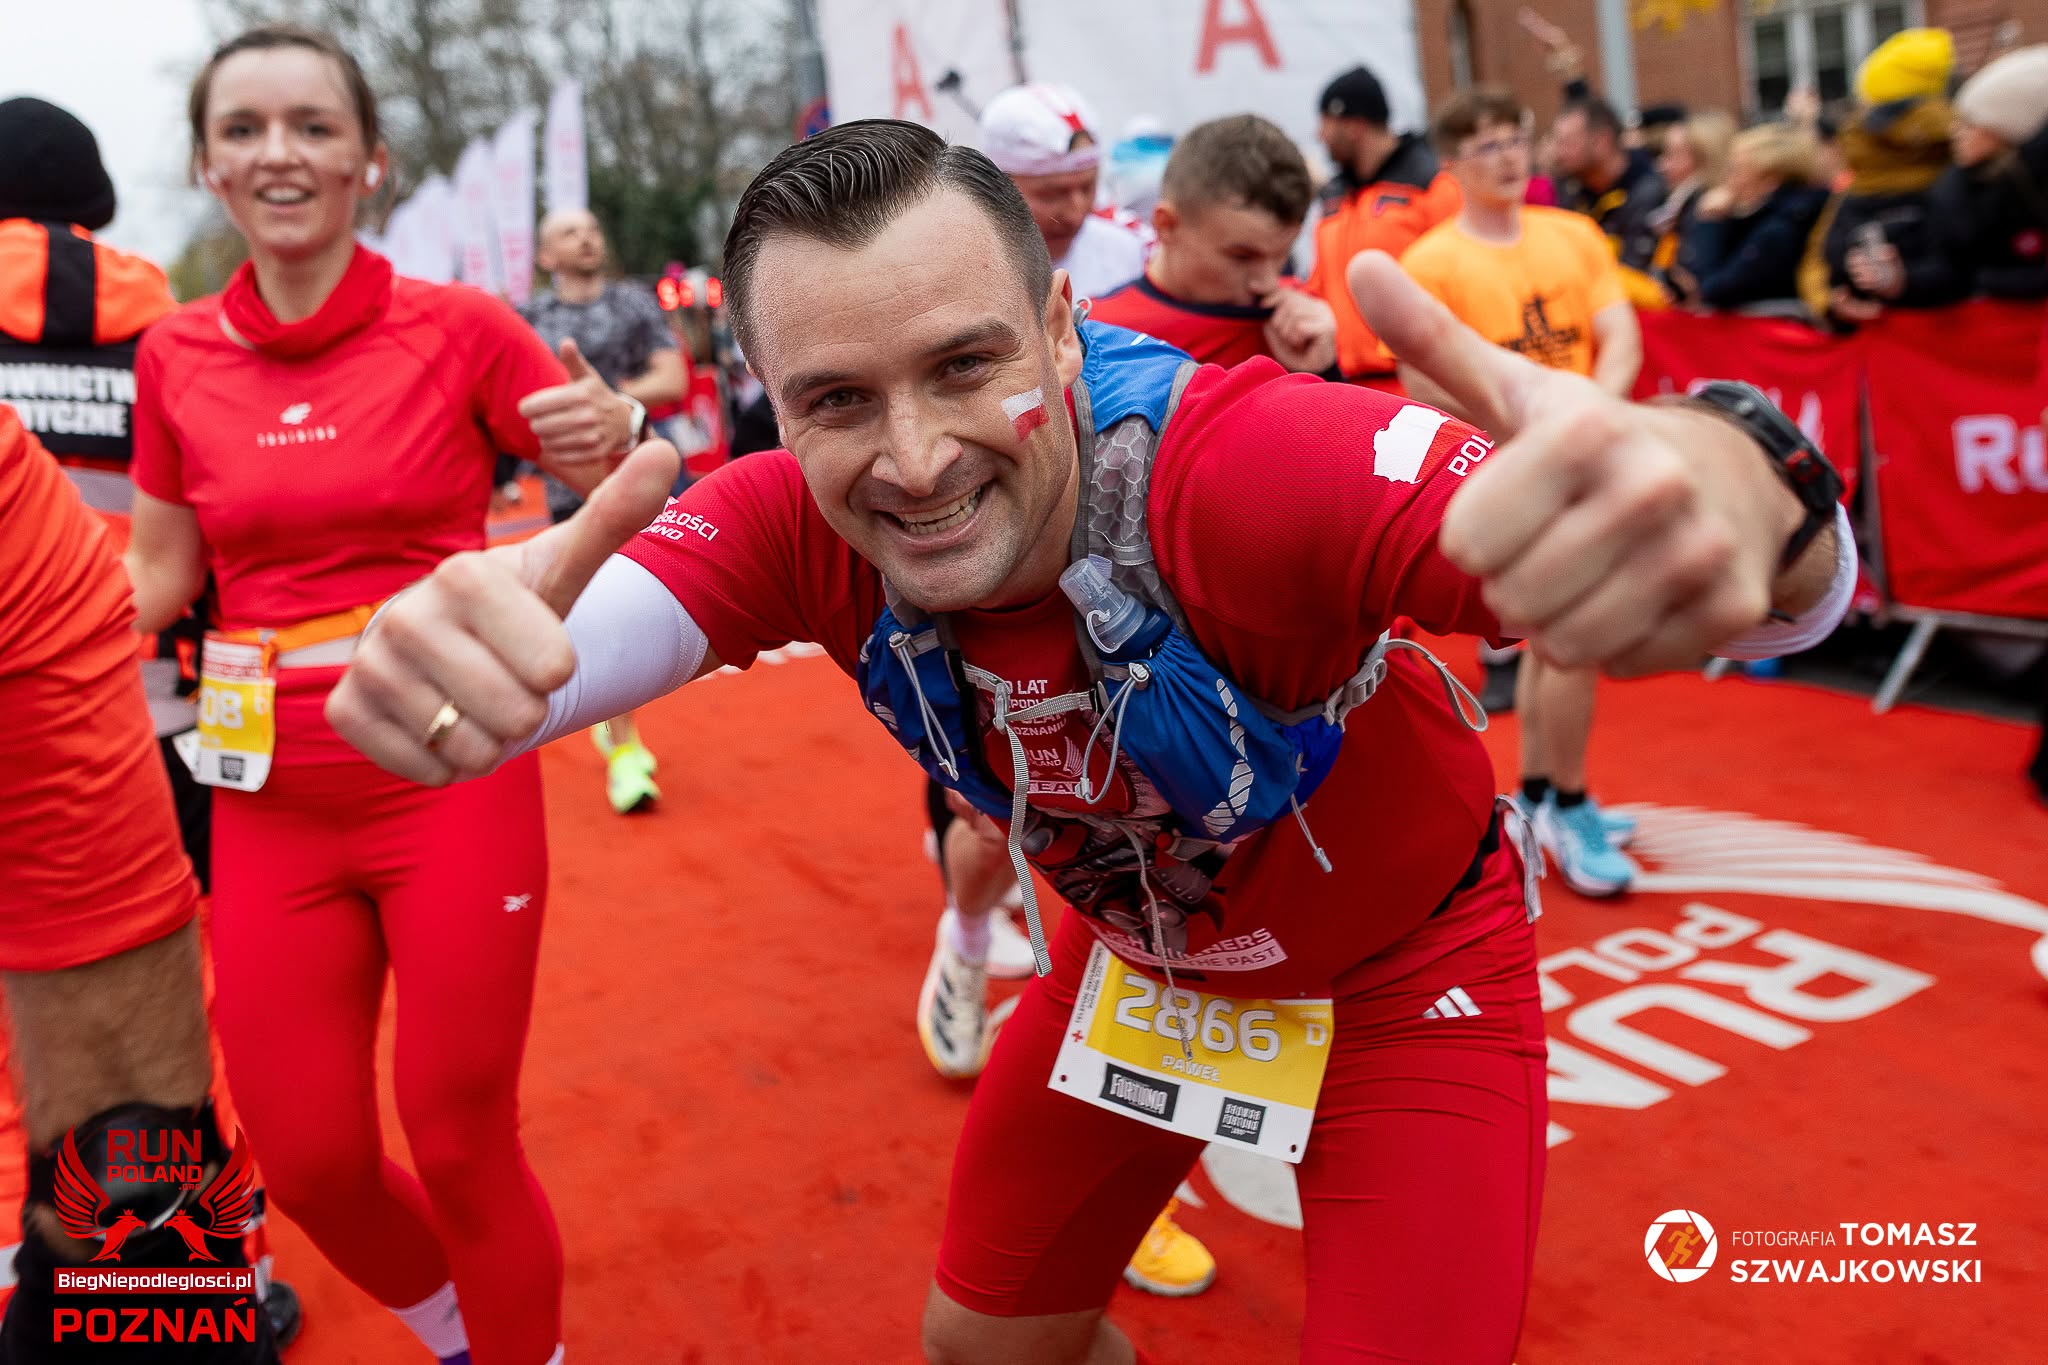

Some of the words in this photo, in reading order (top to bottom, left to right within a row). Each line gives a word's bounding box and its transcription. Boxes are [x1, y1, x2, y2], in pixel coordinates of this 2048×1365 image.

[1446, 433, 1496, 477] POL
[1018, 680, 1048, 694] LAT
[1013, 718, 1067, 736] OZNANIU
[1227, 945, 1279, 967] PAST
[1113, 972, 1282, 1063] 2866
[1306, 1022, 1328, 1046] D
[1161, 1055, 1222, 1082] PAWEŁ
[1109, 1073, 1168, 1115] FORTUNA
